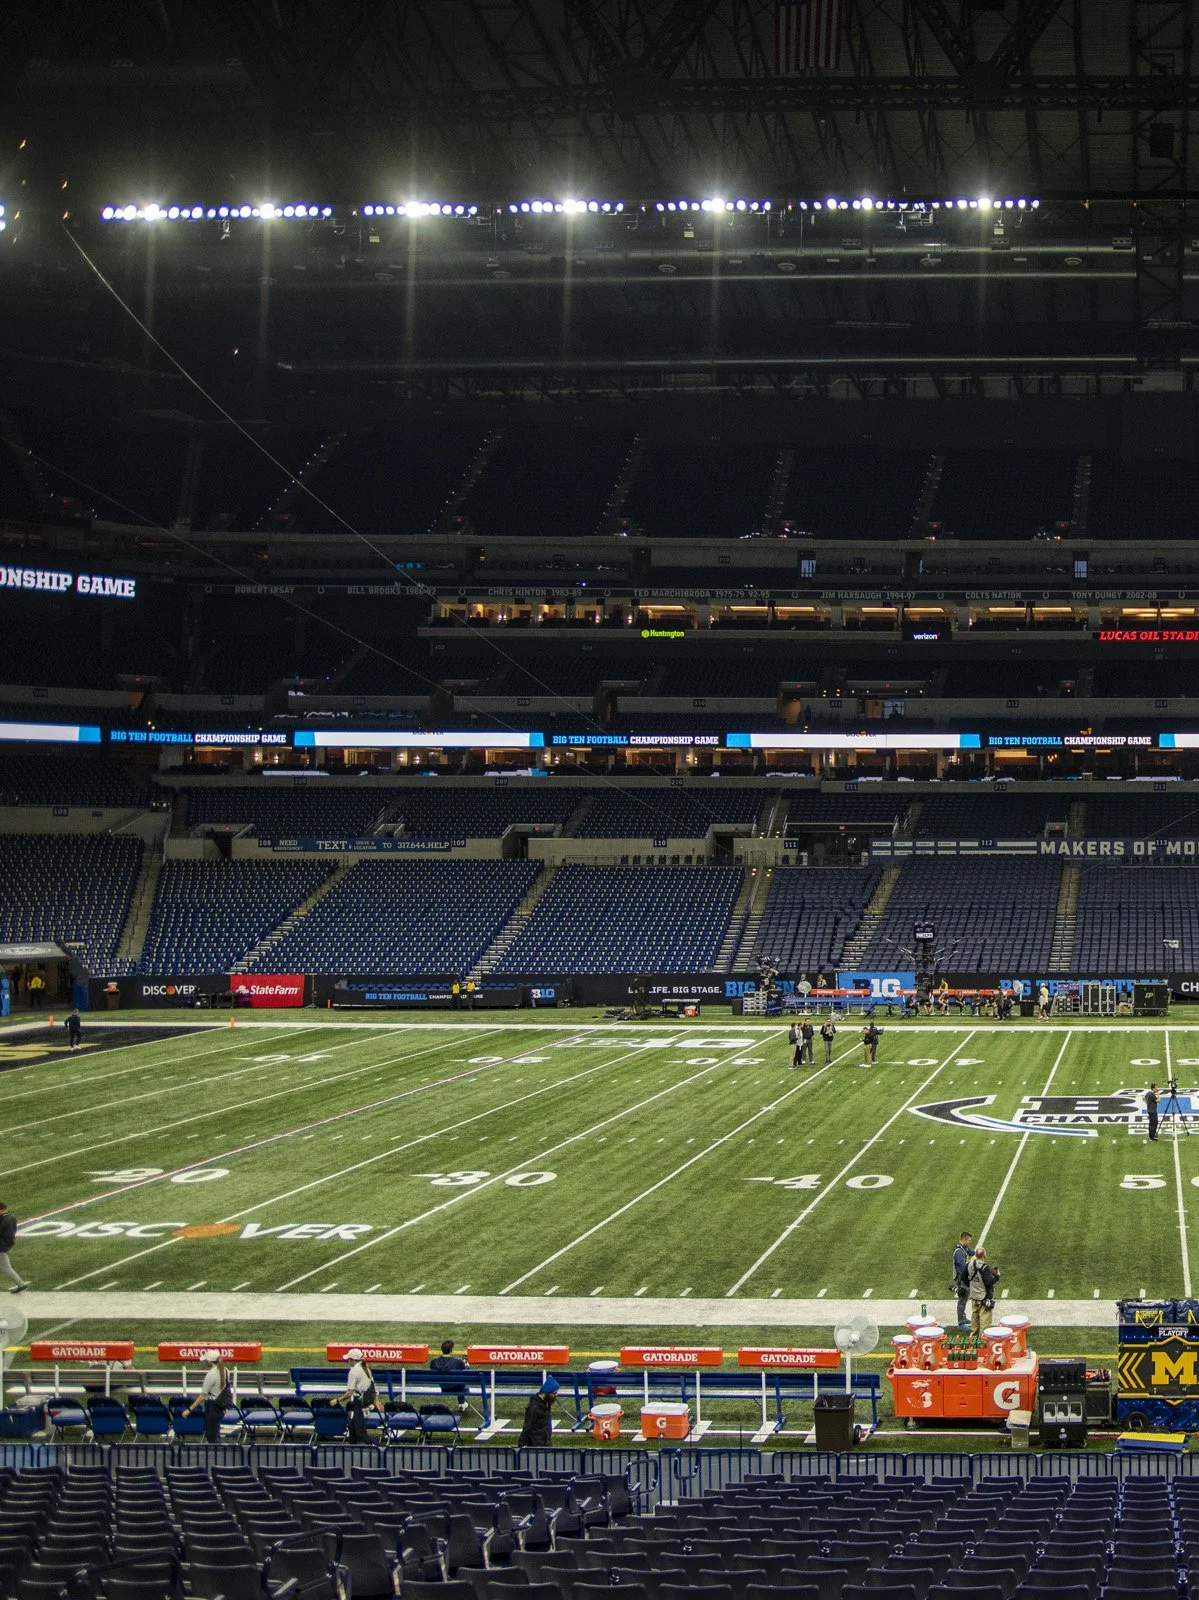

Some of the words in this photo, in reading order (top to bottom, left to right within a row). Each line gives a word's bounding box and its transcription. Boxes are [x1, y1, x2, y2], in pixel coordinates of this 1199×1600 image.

[77, 575, 136, 597] GAME
[488, 588, 516, 597] CHRIS
[519, 588, 546, 597] HINTON
[634, 589, 650, 598] TED
[820, 592, 836, 600] JIM
[838, 592, 882, 600] HARBAUGH
[965, 591, 990, 600] COLTS
[992, 591, 1022, 600] NATION
[1072, 591, 1093, 600] TONY
[1095, 591, 1122, 600] DUNGY
[650, 630, 684, 638] Huntington
[913, 632, 938, 640] verizon
[1100, 632, 1136, 640] LUCAS
[1140, 632, 1160, 640] OIL
[111, 730, 126, 741] BIG
[129, 731, 146, 742] TEN
[149, 732, 193, 742] FOOTBALL
[195, 734, 260, 744] CHAMPIONSHIP
[262, 734, 286, 744] GAME
[552, 735, 566, 745] BIG
[568, 735, 584, 745] TEN
[586, 735, 628, 745] FOOTBALL
[630, 735, 692, 745] CHAMPIONSHIP
[693, 735, 719, 745] GAME
[988, 736, 1002, 746] BIG
[1004, 736, 1020, 746] TEN
[1022, 736, 1062, 746] FOOTBALL
[1064, 736, 1126, 746] CHAMPIONSHIP
[1127, 736, 1152, 746] GAME
[397, 841, 450, 849] 317.644.HELP
[1041, 841, 1125, 856] MAKERS
[1133, 841, 1156, 856] OF
[143, 984, 196, 996] DISCOVER
[18, 1221, 375, 1240] DISCOVER
[52, 1347, 106, 1356] GATORADE
[922, 1343, 932, 1355] G
[992, 1343, 1002, 1355] G
[489, 1351, 544, 1361] GATORADE
[642, 1352, 698, 1362] GATORADE
[760, 1354, 816, 1364] GATORADE
[1152, 1352, 1198, 1384] M
[993, 1381, 1020, 1410] G
[656, 1417, 667, 1428] G
